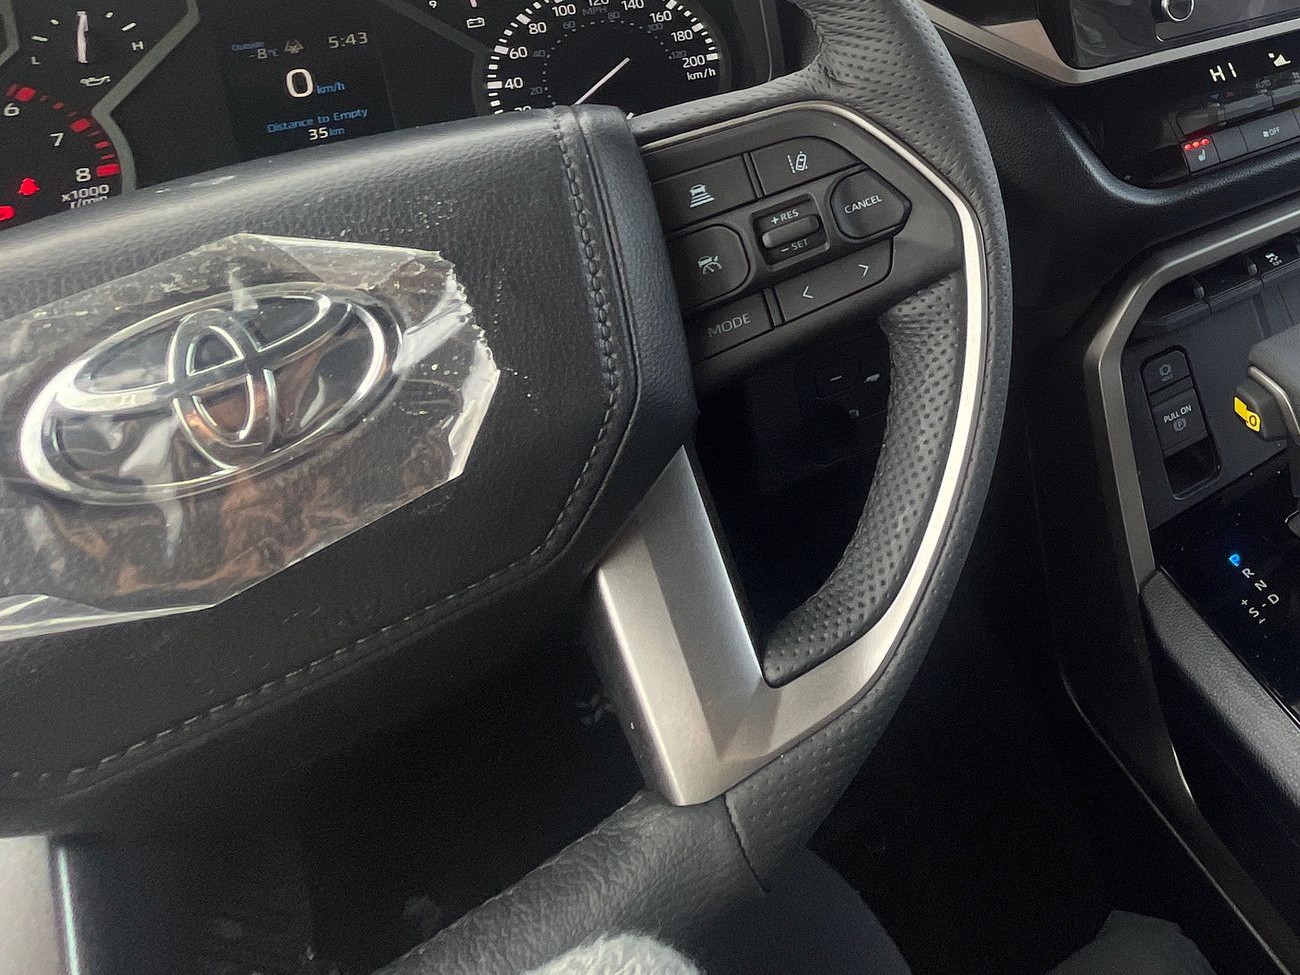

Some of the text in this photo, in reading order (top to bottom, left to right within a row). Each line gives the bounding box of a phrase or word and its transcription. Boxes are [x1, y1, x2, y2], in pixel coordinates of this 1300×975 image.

[428, 0, 438, 9] 9
[551, 4, 577, 17] 100
[582, 6, 608, 16] MPH
[607, 11, 621, 20] 80
[649, 10, 673, 23] 160
[528, 22, 547, 35] 80
[562, 20, 576, 29] 60
[328, 31, 369, 49] 5:43
[671, 29, 694, 42] 180
[131, 41, 144, 51] H
[509, 46, 528, 60] 60
[671, 50, 688, 59] 120
[31, 56, 41, 65] L
[681, 54, 706, 68] 200
[686, 67, 717, 81] km/h
[1209, 62, 1237, 82] HI
[286, 68, 345, 98] 0 km/h
[504, 76, 524, 90] 40
[1255, 78, 1272, 89] AUTO
[529, 86, 544, 96] 20
[3, 102, 20, 117] 6
[266, 108, 369, 133] Distance to Empty
[308, 126, 329, 140] 35
[1268, 126, 1280, 136] OFF
[49, 132, 64, 147] 7
[75, 167, 92, 182] 8
[61, 184, 110, 203] x1000
[844, 194, 883, 214] CANCEL
[707, 312, 751, 338] MODE
[1163, 404, 1192, 423] PULL ON
[1241, 567, 1255, 579] R
[1254, 579, 1267, 591] N
[1267, 593, 1280, 605] D
[1248, 607, 1260, 618] S
